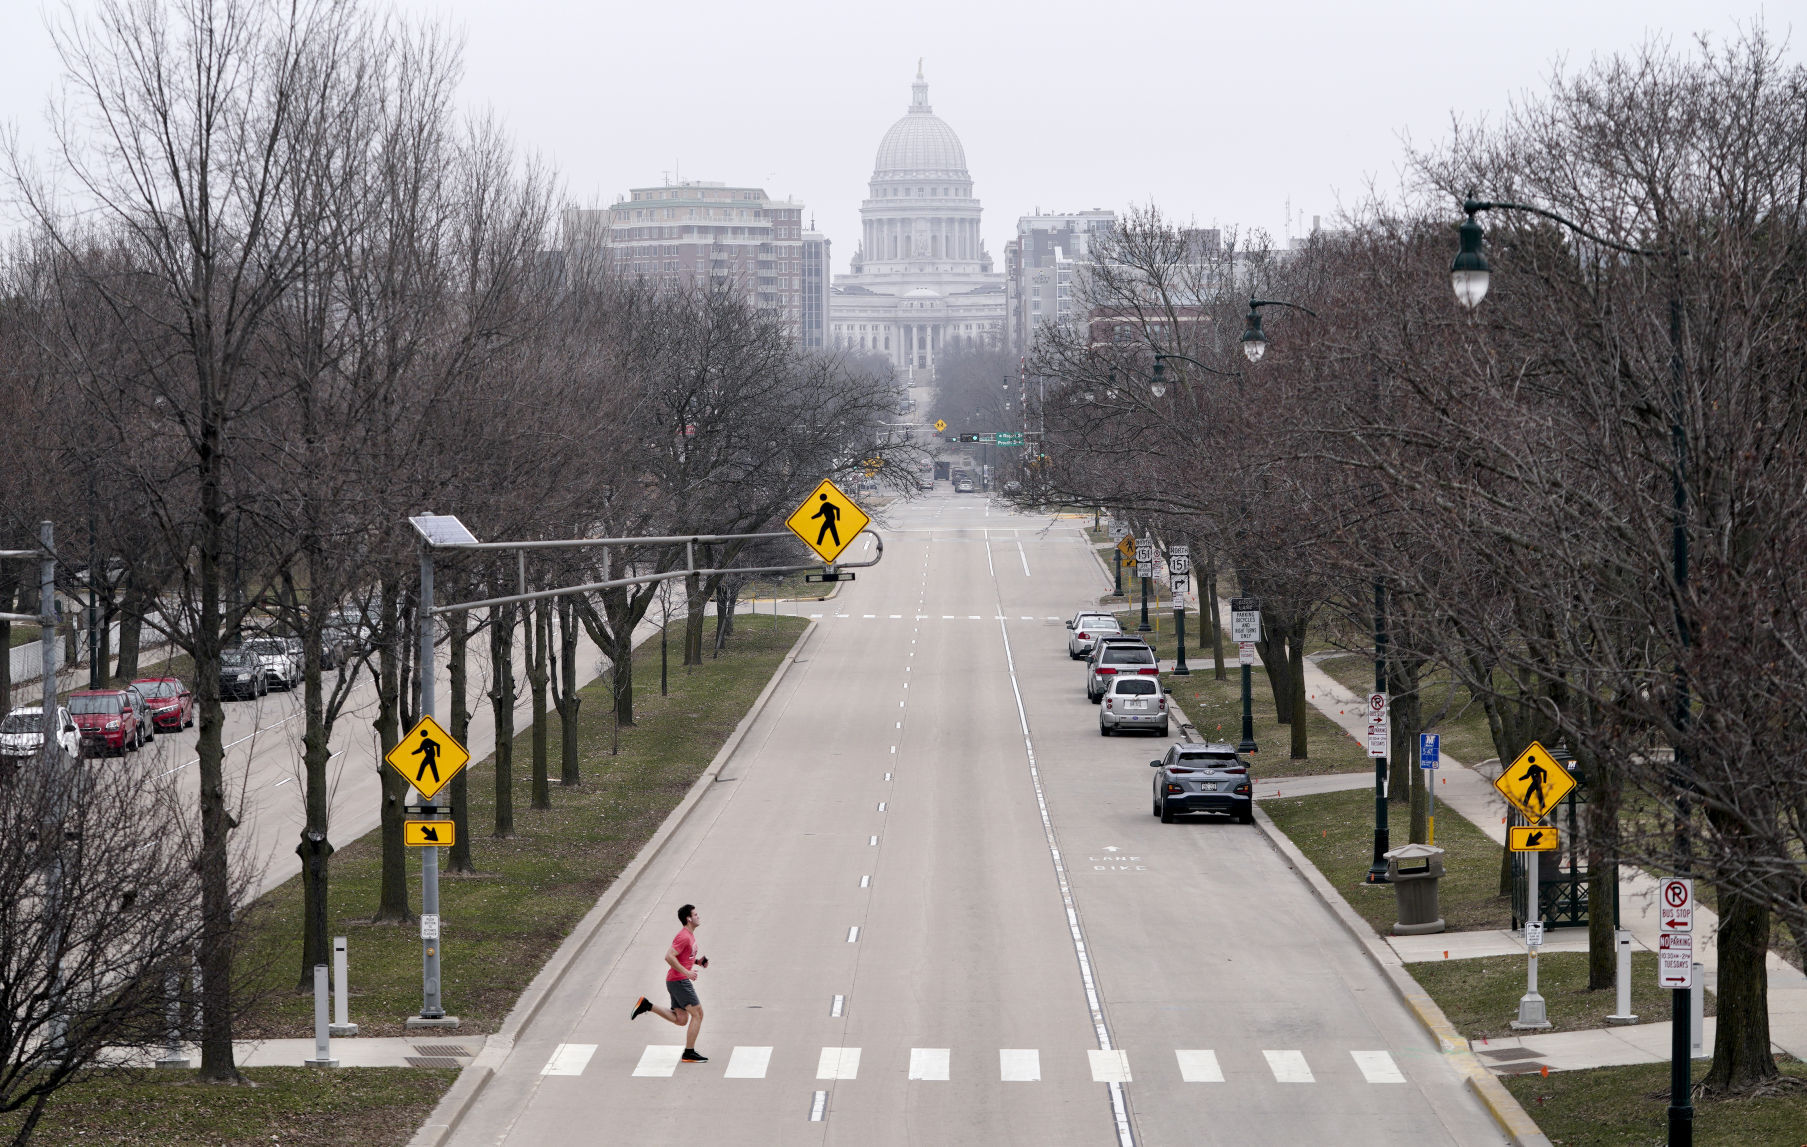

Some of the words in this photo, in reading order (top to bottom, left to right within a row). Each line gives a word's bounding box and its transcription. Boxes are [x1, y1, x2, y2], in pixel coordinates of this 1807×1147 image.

[1138, 550, 1150, 559] 151
[1173, 559, 1187, 571] 151
[1662, 909, 1674, 918] BUS
[1676, 909, 1691, 918] STOP
[1660, 936, 1669, 947] NO
[1670, 938, 1691, 947] PARKING
[1664, 960, 1688, 969] TUESDAYS
